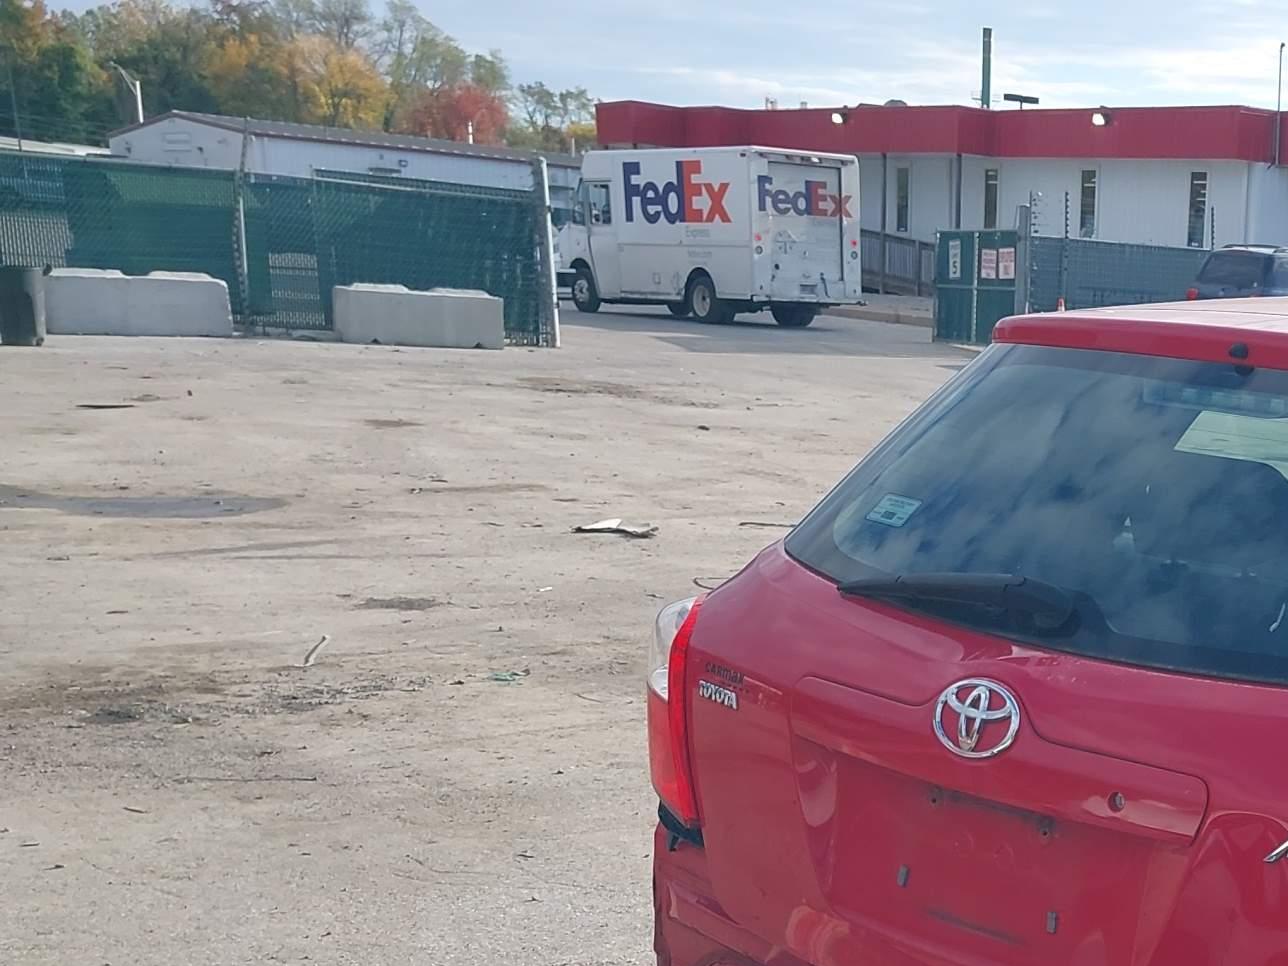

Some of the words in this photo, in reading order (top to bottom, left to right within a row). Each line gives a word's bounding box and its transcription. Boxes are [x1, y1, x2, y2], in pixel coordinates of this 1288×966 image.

[622, 160, 733, 224] FedEx
[757, 174, 854, 219] FedEx
[698, 679, 738, 710] TOYOTA
